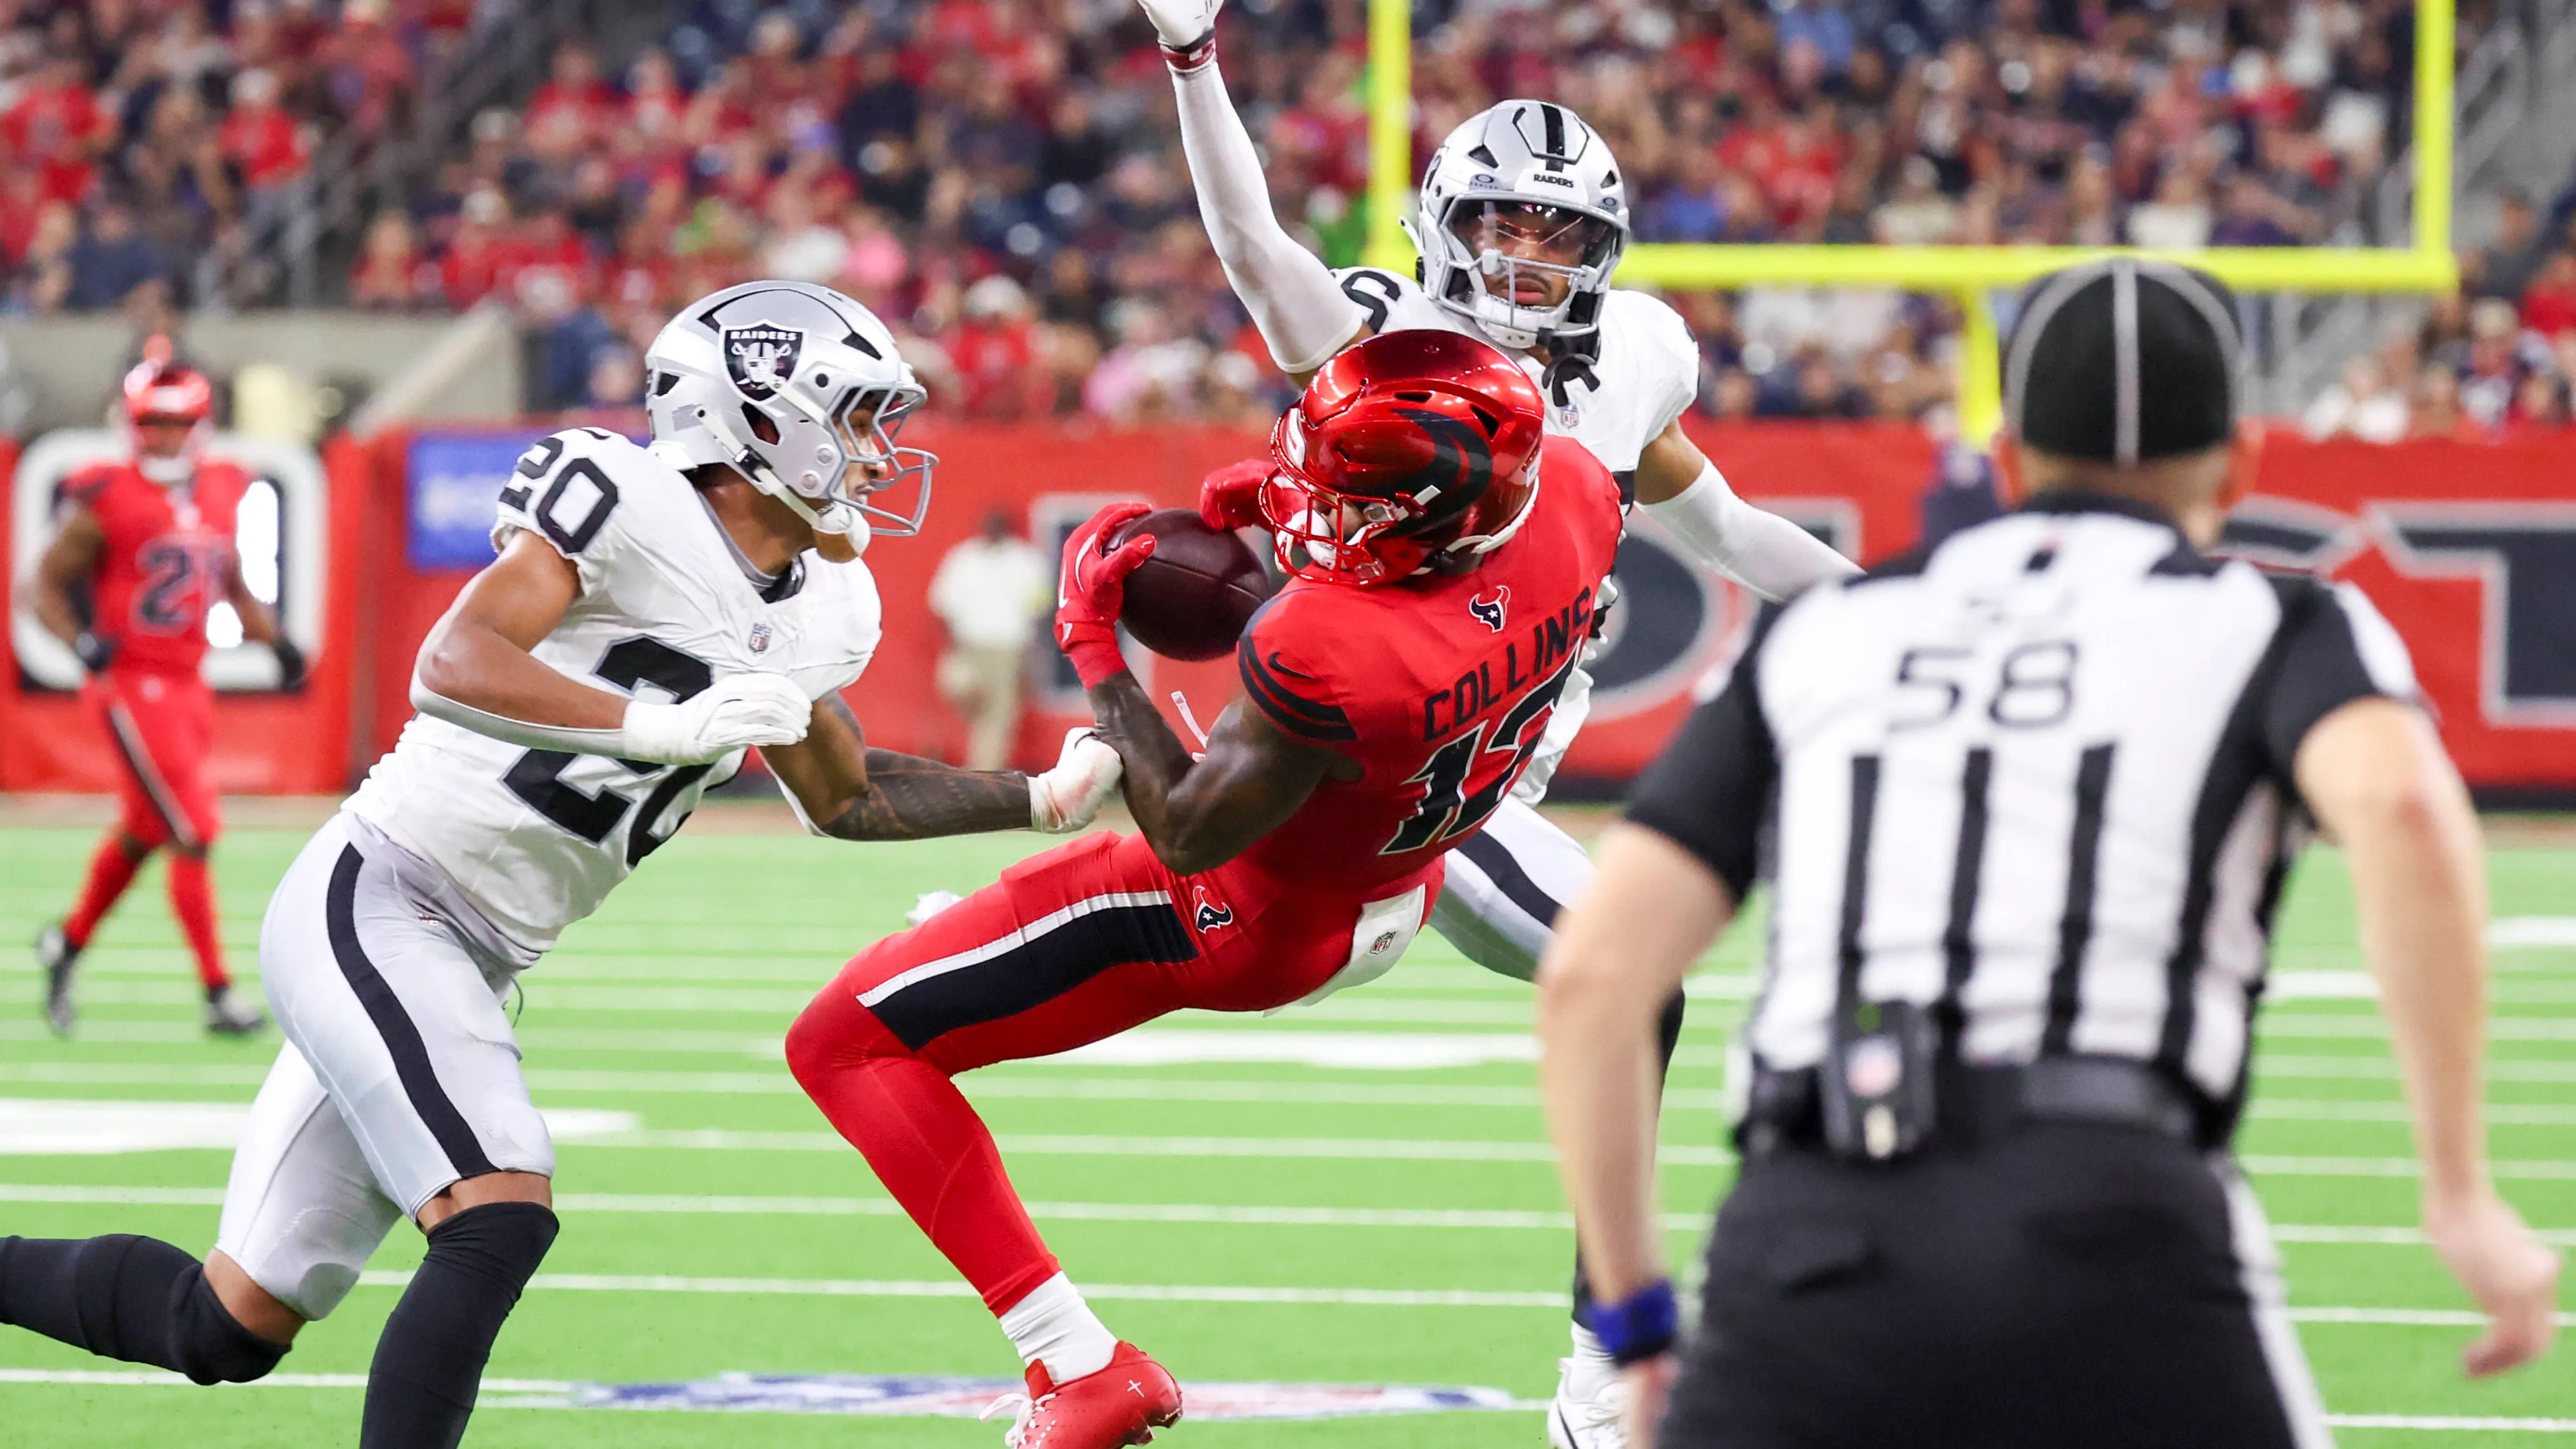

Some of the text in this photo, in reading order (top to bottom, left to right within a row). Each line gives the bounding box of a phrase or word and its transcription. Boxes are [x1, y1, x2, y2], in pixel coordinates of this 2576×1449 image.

[1533, 174, 1574, 188] RAIDERS
[730, 331, 797, 341] RAIDERS
[499, 437, 619, 553] 20
[1424, 586, 1591, 742] COLLINS
[1886, 641, 2078, 733] 58
[1377, 634, 1585, 856] 12
